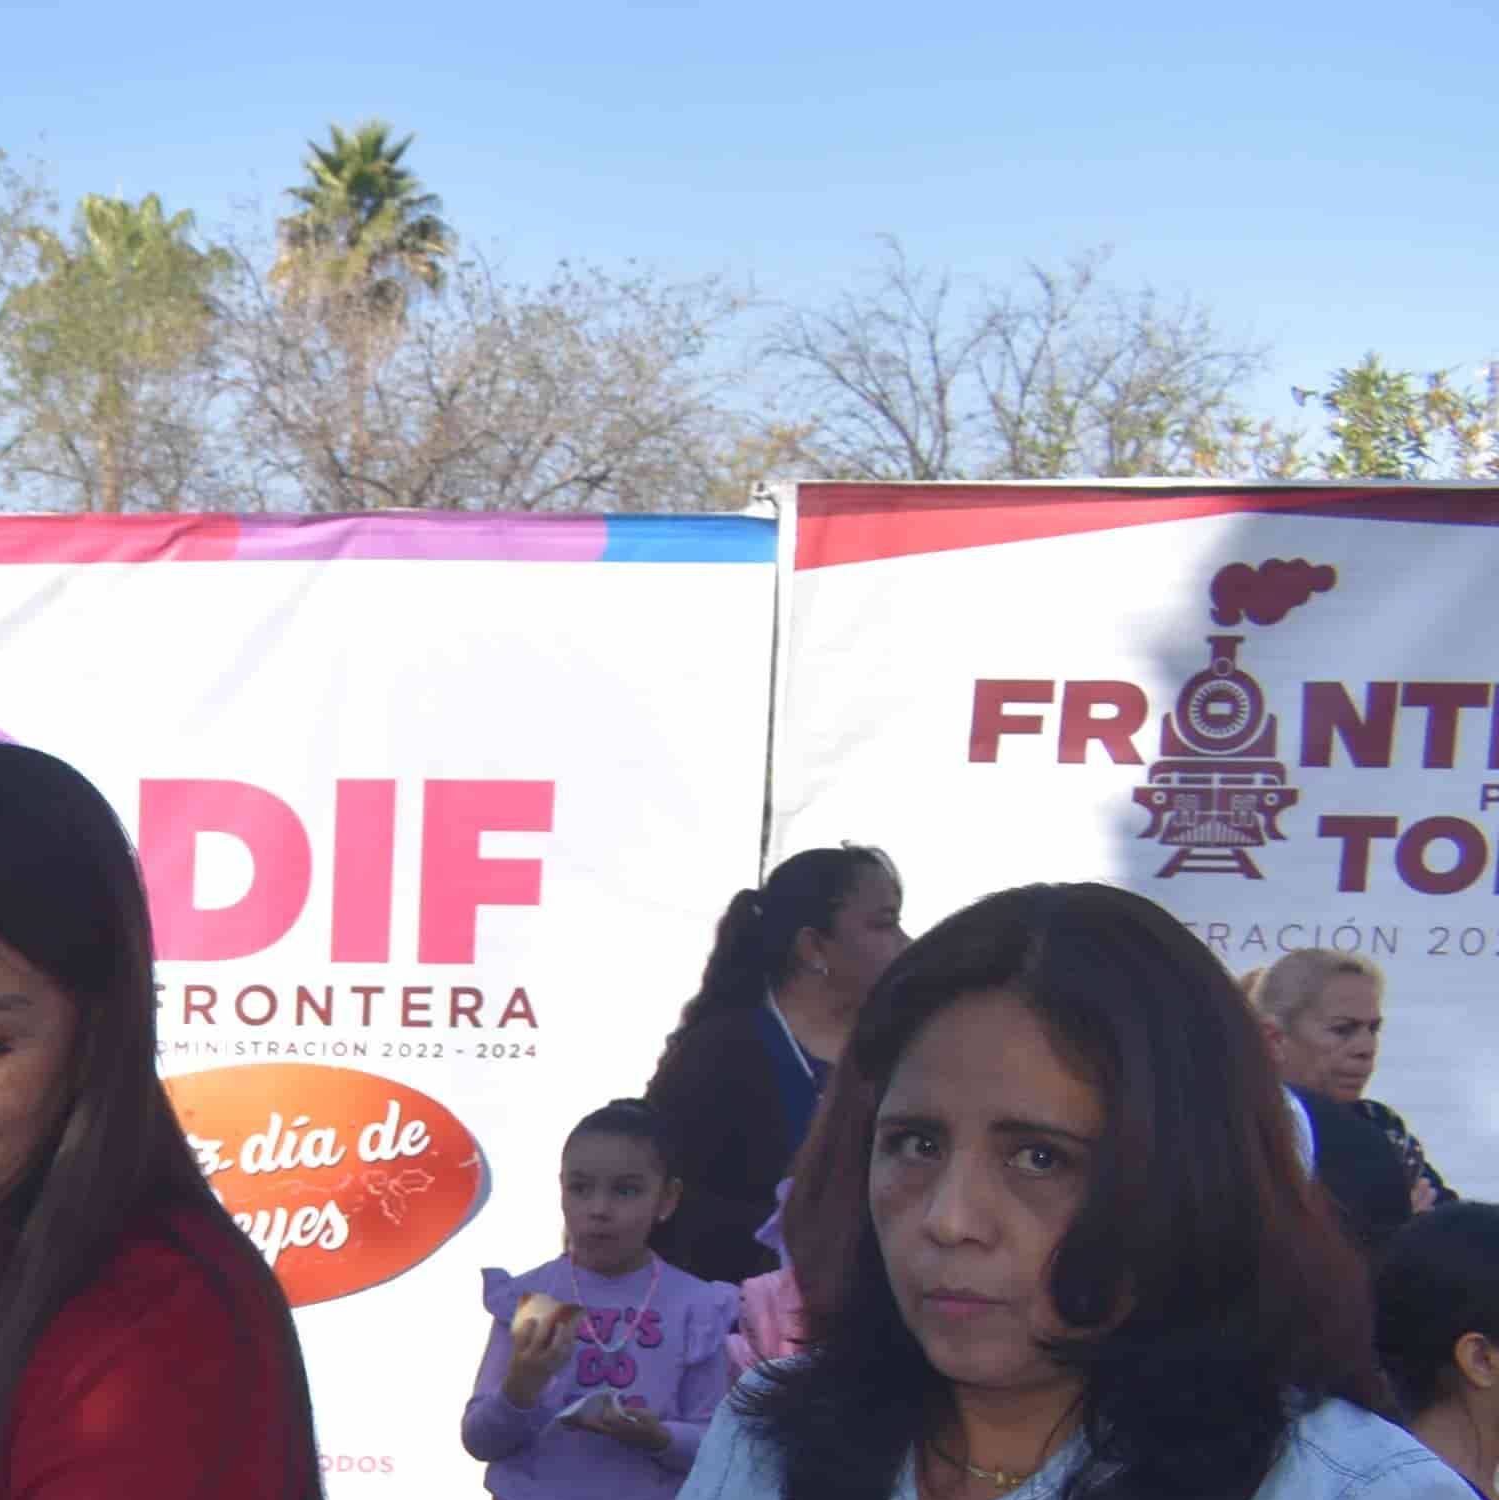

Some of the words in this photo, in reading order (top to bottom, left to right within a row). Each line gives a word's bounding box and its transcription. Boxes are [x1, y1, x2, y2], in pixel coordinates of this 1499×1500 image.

[138, 778, 555, 965] DIF
[1317, 814, 1499, 896] TO
[1426, 926, 1499, 957] 20
[382, 1042, 444, 1058] 2022
[476, 1043, 537, 1059] 2024
[239, 1112, 345, 1176] día
[357, 1099, 432, 1163] de
